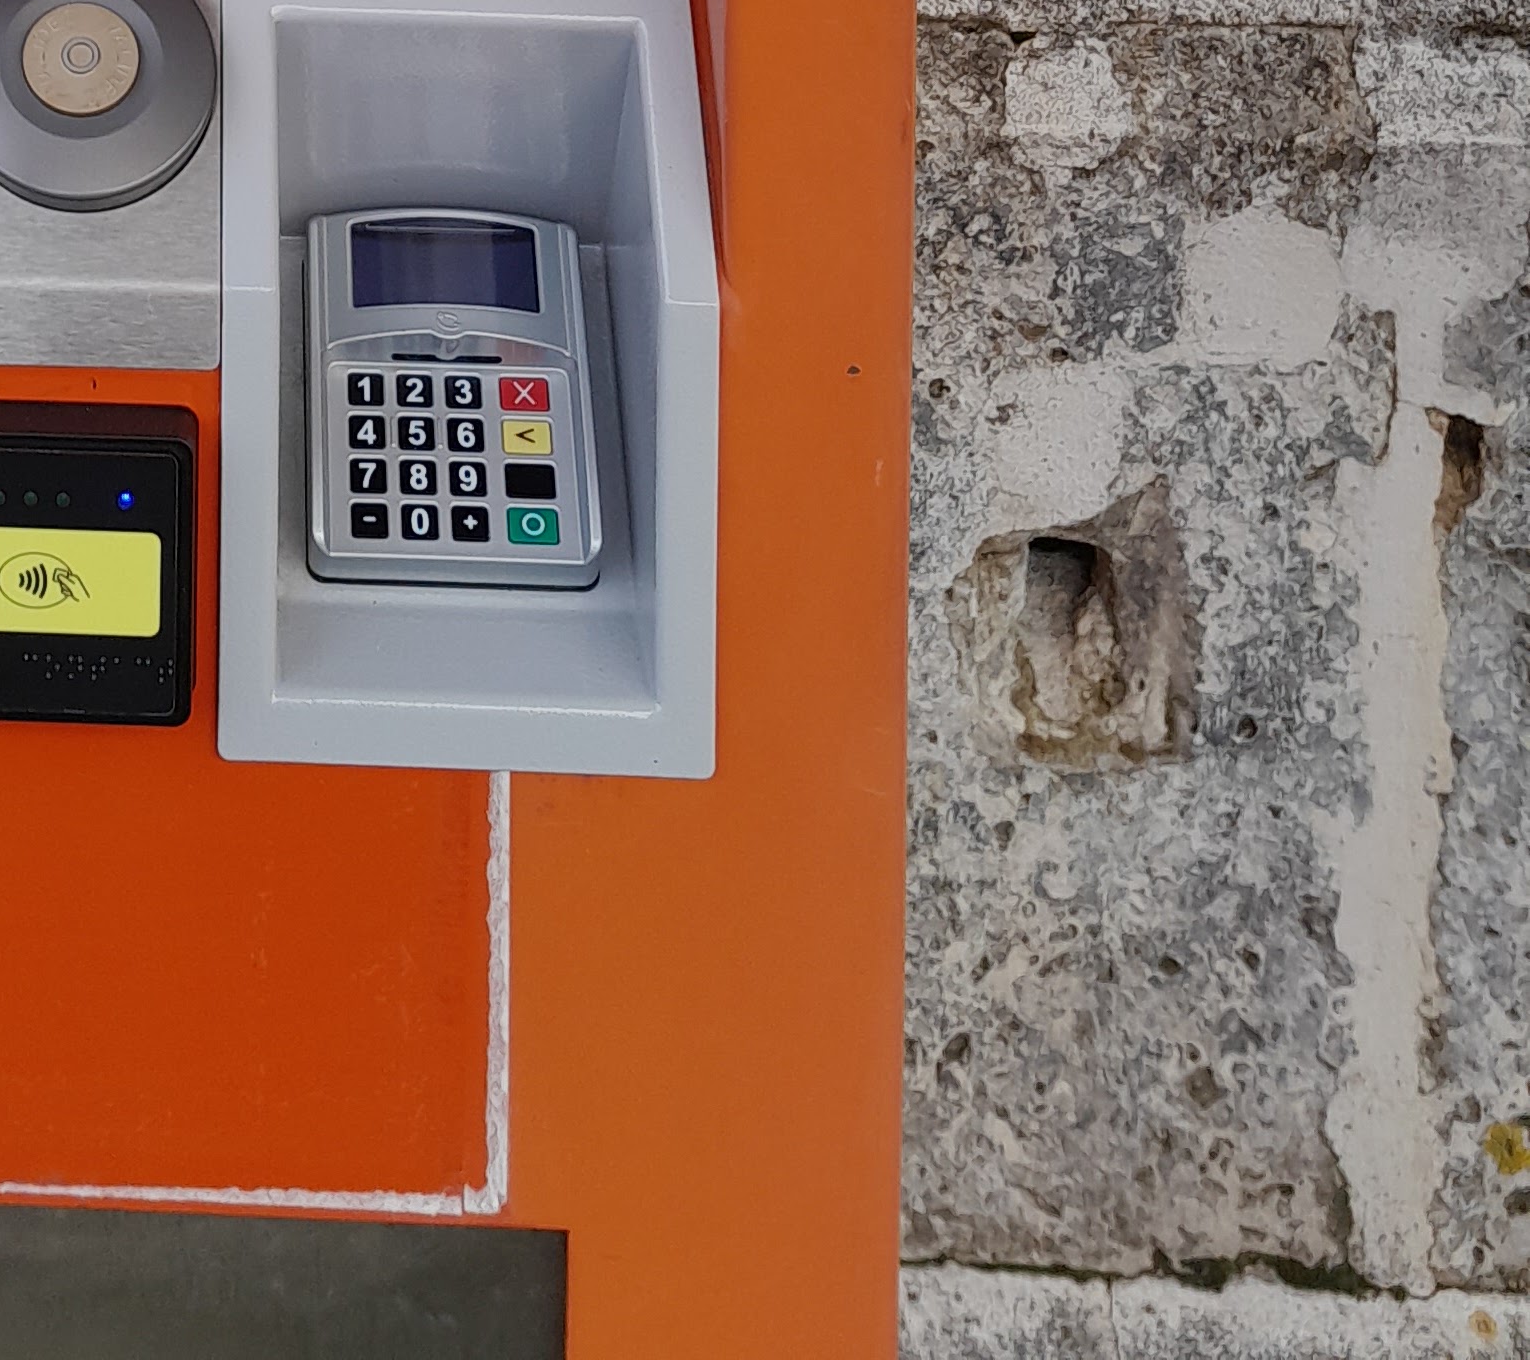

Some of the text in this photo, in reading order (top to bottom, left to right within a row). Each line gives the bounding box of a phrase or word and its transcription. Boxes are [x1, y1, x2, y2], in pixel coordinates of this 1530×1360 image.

[357, 378, 473, 404] 1 2 3
[357, 420, 476, 448] 4 5 6
[359, 463, 478, 492] 7 8 9
[411, 507, 430, 535] 0
